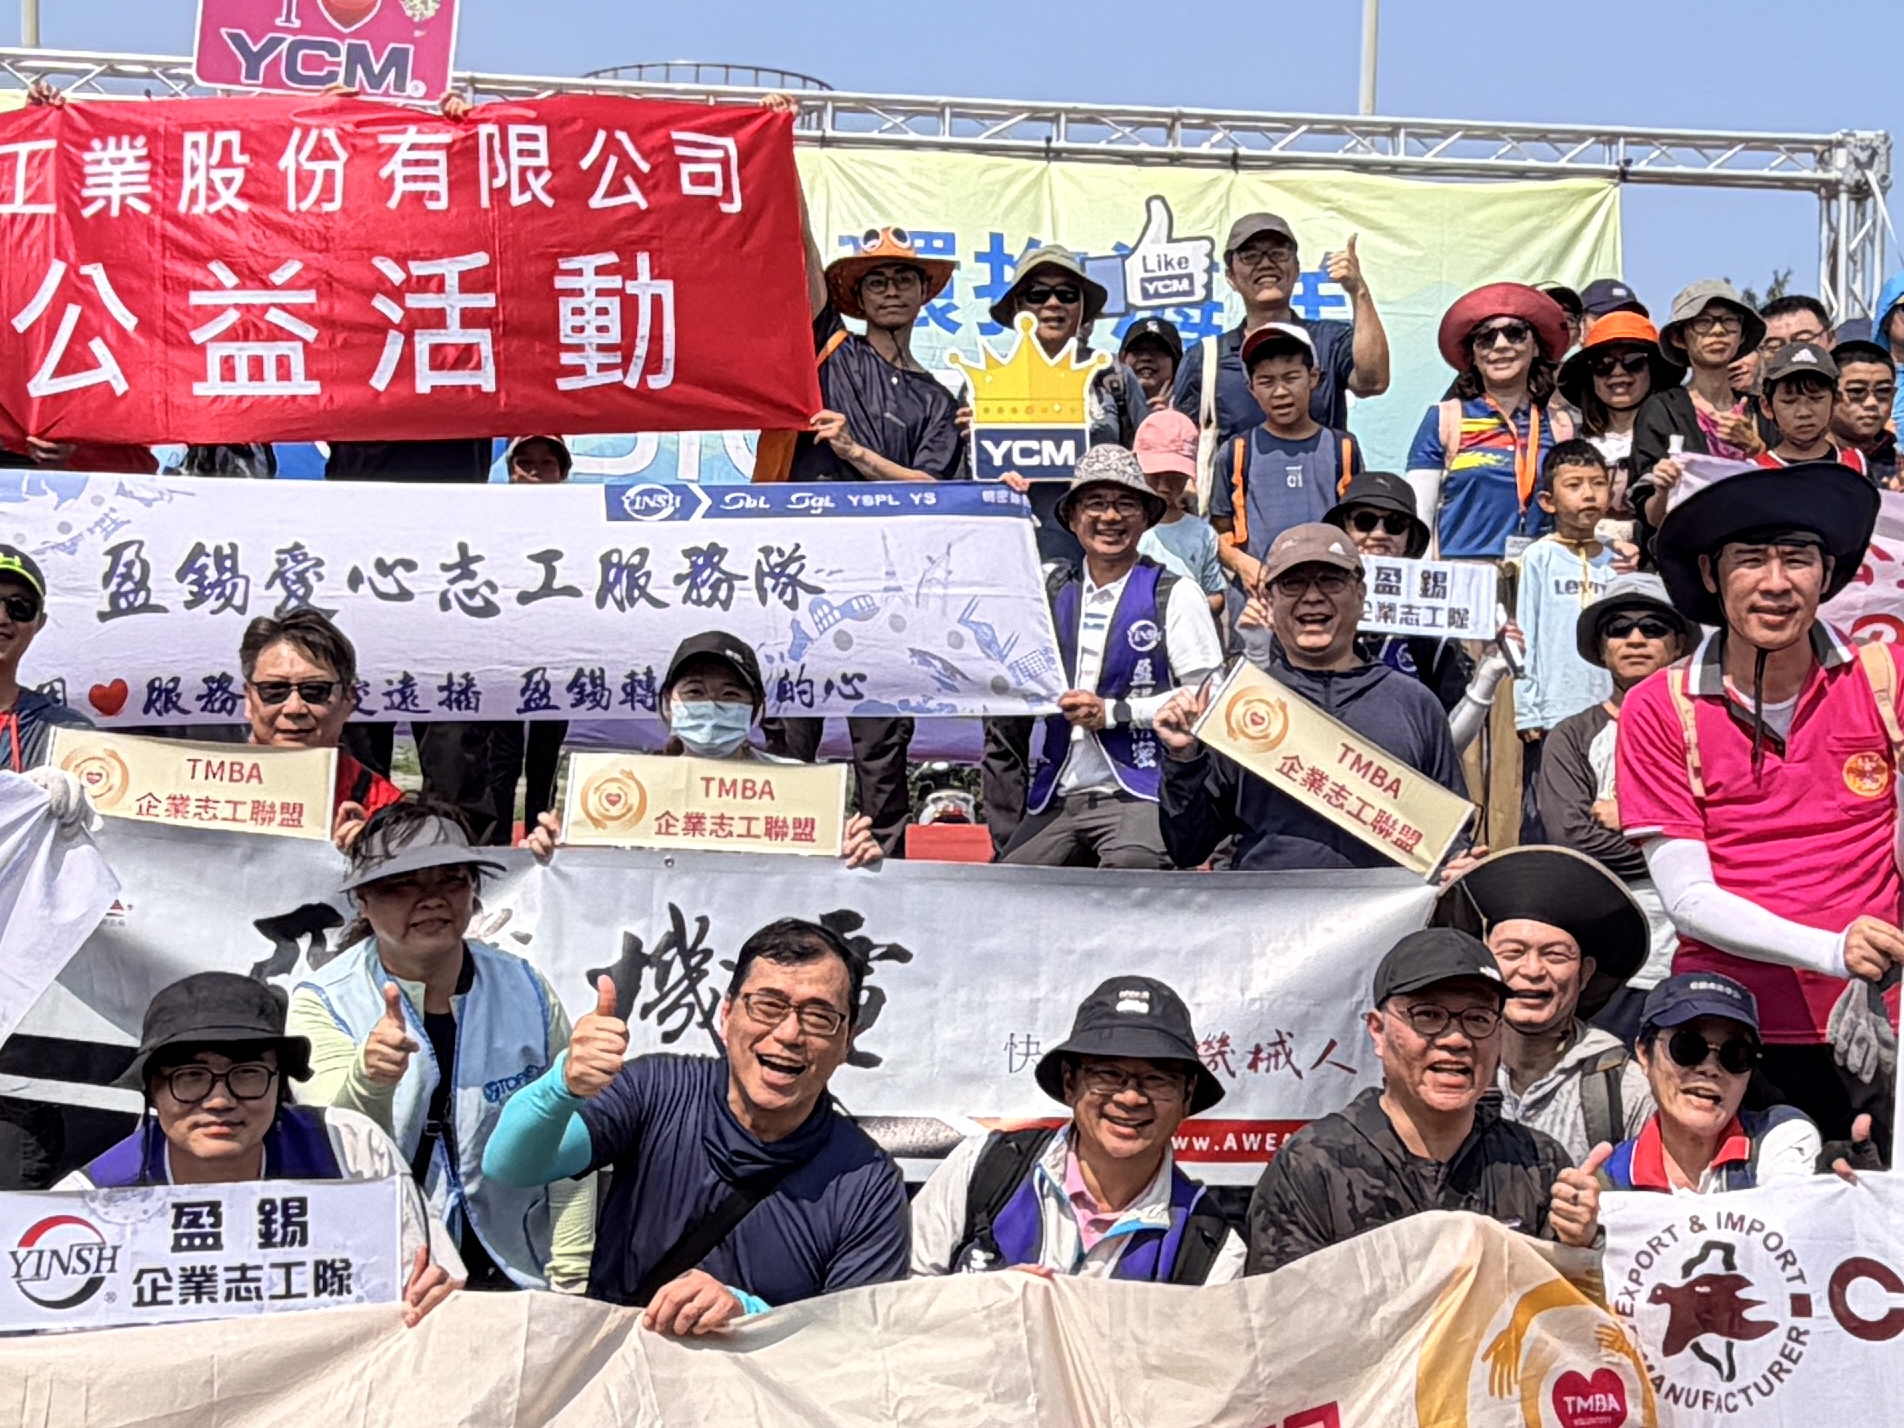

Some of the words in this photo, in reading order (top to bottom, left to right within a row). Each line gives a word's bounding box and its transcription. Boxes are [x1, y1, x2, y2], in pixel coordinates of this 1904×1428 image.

[1142, 253, 1190, 272] Like
[1143, 279, 1193, 294] YCM
[981, 439, 1076, 467] YCM
[97, 539, 825, 622] 盈錫愛心志工服務隊
[187, 757, 264, 785] TMBA
[700, 777, 776, 802] TMBA
[1337, 743, 1402, 800] TMBA
[135, 791, 305, 829] 企業志工聯盟
[1275, 755, 1425, 854] 企業志工聯盟
[655, 813, 816, 843] 企業志工聯盟
[171, 1196, 309, 1254] 盈錫
[8, 1243, 122, 1282] YINSH
[1615, 1224, 1680, 1318] EXPORT
[1689, 1215, 1707, 1233] &
[1717, 1211, 1807, 1285] IMPORT
[133, 1258, 352, 1308] 企業志工隊
[1563, 1393, 1621, 1414] TMBA
